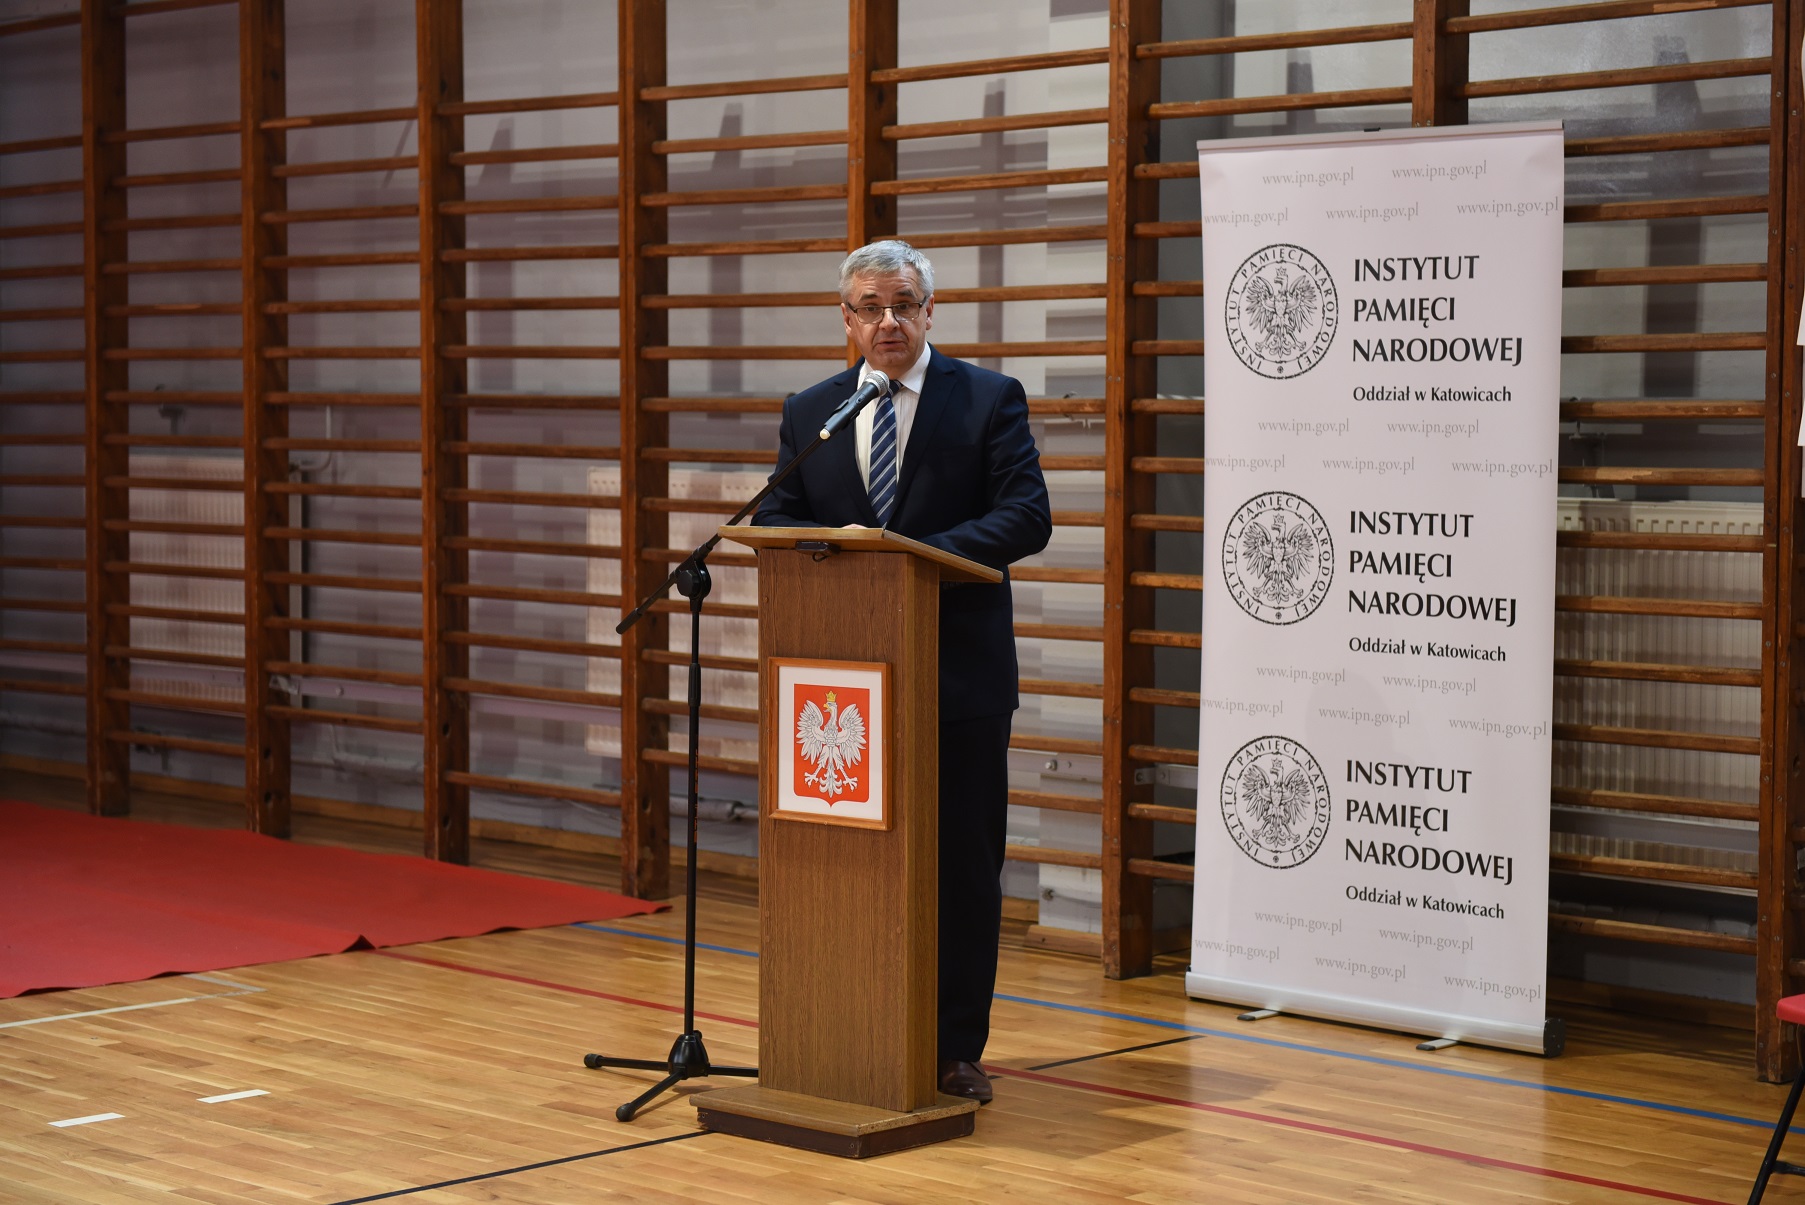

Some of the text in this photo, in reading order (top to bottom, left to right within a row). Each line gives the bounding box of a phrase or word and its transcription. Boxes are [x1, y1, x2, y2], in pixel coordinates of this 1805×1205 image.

[1262, 167, 1354, 187] www.ipn.gov.pl
[1392, 160, 1487, 182] www.ipn.gov.pl
[1204, 207, 1289, 227] www.ipn.gov.pl
[1326, 202, 1419, 222] www.ipn.gov.pl
[1457, 196, 1559, 217] www.ipn.gov.pl
[1354, 255, 1480, 282] INSTYTUT
[1228, 288, 1261, 369] INSTYTUT
[1298, 263, 1335, 370] NARODOWEJ
[1353, 297, 1456, 328] PAMIĘCI
[1352, 337, 1523, 367] NARODOWEJ
[1353, 386, 1512, 402] Oddział w Katowicach
[1258, 418, 1350, 436] www.ipn.gov.pl
[1387, 419, 1480, 438] www.ipn.gov.pl
[1322, 456, 1415, 475] www.ipn.gov.pl
[1451, 459, 1553, 478] www.ipn.gov.pl
[1350, 510, 1474, 538] INSTYTUT
[1226, 532, 1259, 614] INSTYTUT
[1295, 513, 1331, 617] NARODOWEJ
[1349, 551, 1452, 583] PAMIĘCI
[1348, 590, 1517, 627] NARODOWEJ
[1349, 637, 1506, 662] Oddział w Katowicach
[1256, 665, 1345, 684] www.ipn.gov.pl
[1383, 674, 1476, 696] www.ipn.gov.pl
[1318, 706, 1410, 725] www.ipn.gov.pl
[1449, 717, 1547, 739] www.ipn.gov.pl
[1346, 760, 1472, 794] INSTYTUT
[1224, 773, 1259, 857] INSTYTUT
[1291, 759, 1327, 862] NARODOWEJ
[1346, 799, 1448, 836] PAMIĘCI
[1345, 838, 1514, 886] NARODOWEJ
[1346, 885, 1505, 919] Oddział w Katowicach
[1254, 910, 1342, 933] www.ipn.gov.pl
[1195, 940, 1280, 962] www.ipn.gov.pl
[1379, 926, 1473, 952] www.ipn.gov.pl
[1315, 955, 1406, 980] www.ipn.gov.pl
[1444, 973, 1541, 1000] www.ipn.gov.pl
